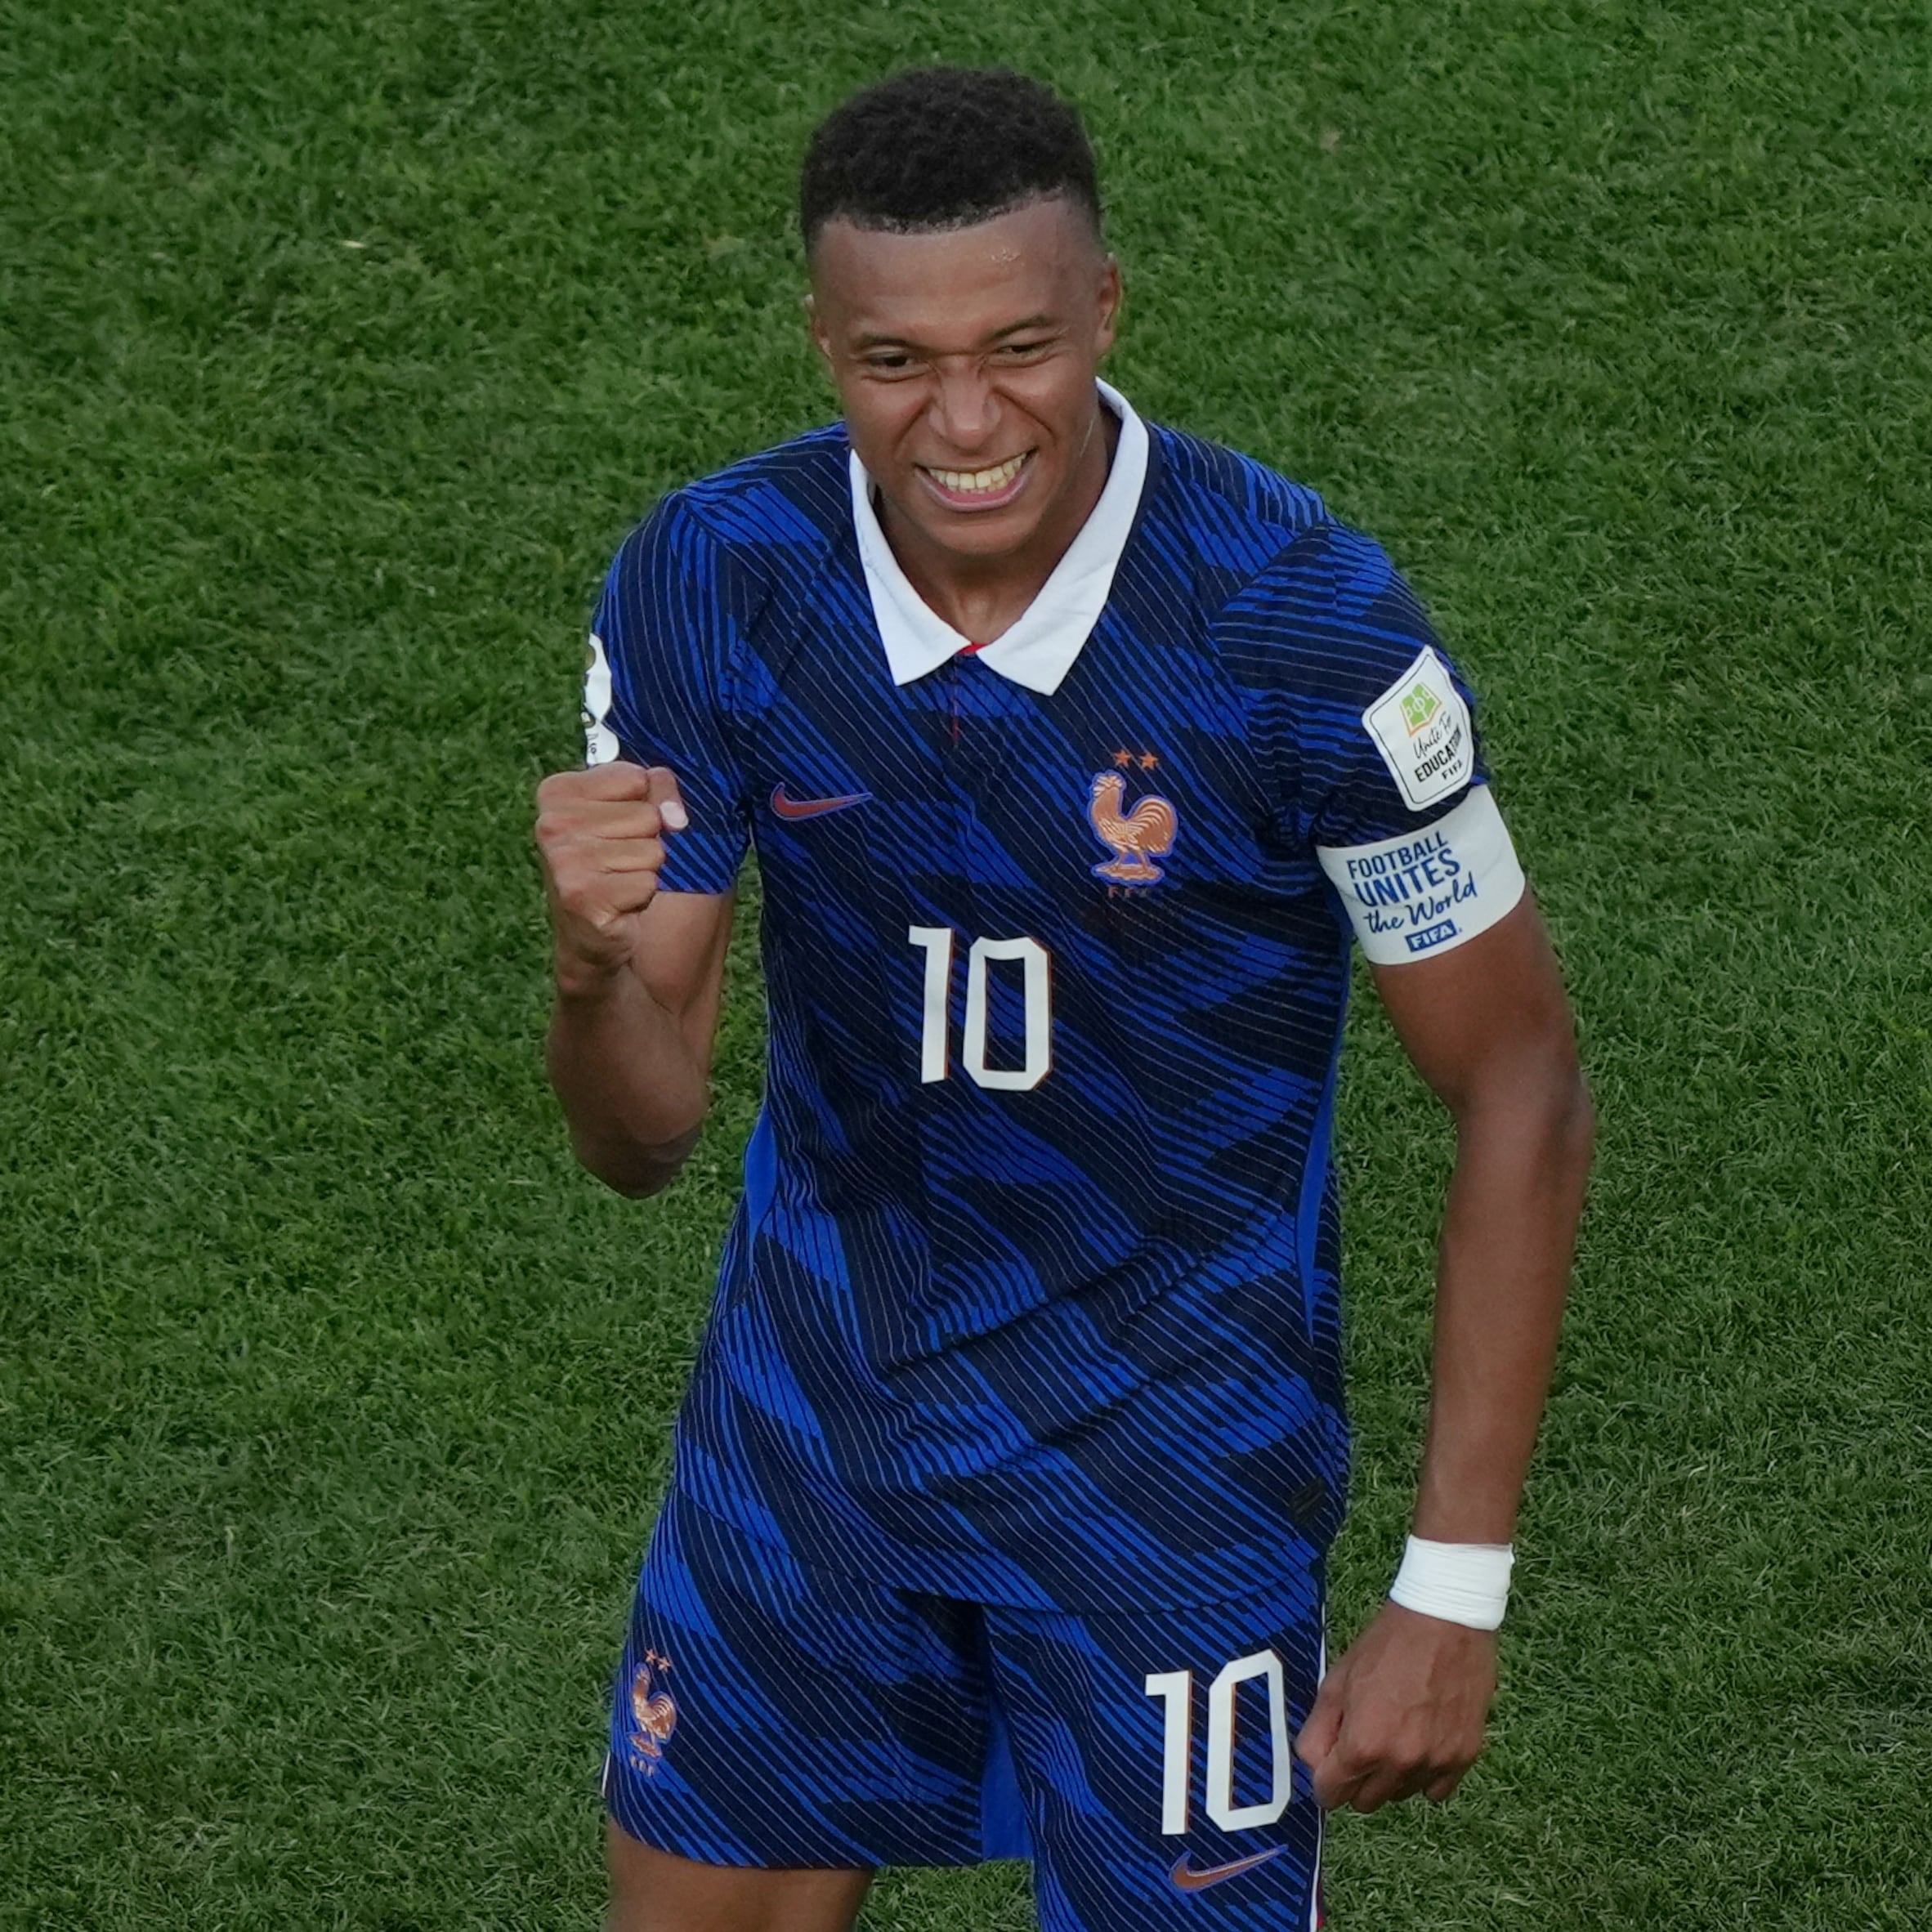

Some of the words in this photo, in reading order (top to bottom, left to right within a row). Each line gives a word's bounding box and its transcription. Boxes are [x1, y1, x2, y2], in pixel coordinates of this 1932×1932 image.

[1413, 726, 1442, 758] Unite
[1441, 758, 1462, 780] FIFA
[1347, 830, 1448, 879] FOOTBALL
[1353, 847, 1460, 907] UNITES
[1363, 909, 1404, 933] the
[1406, 871, 1478, 925] World
[1408, 922, 1455, 950] FIFA
[909, 924, 1051, 1091] 10
[1145, 1648, 1291, 1836] 10
